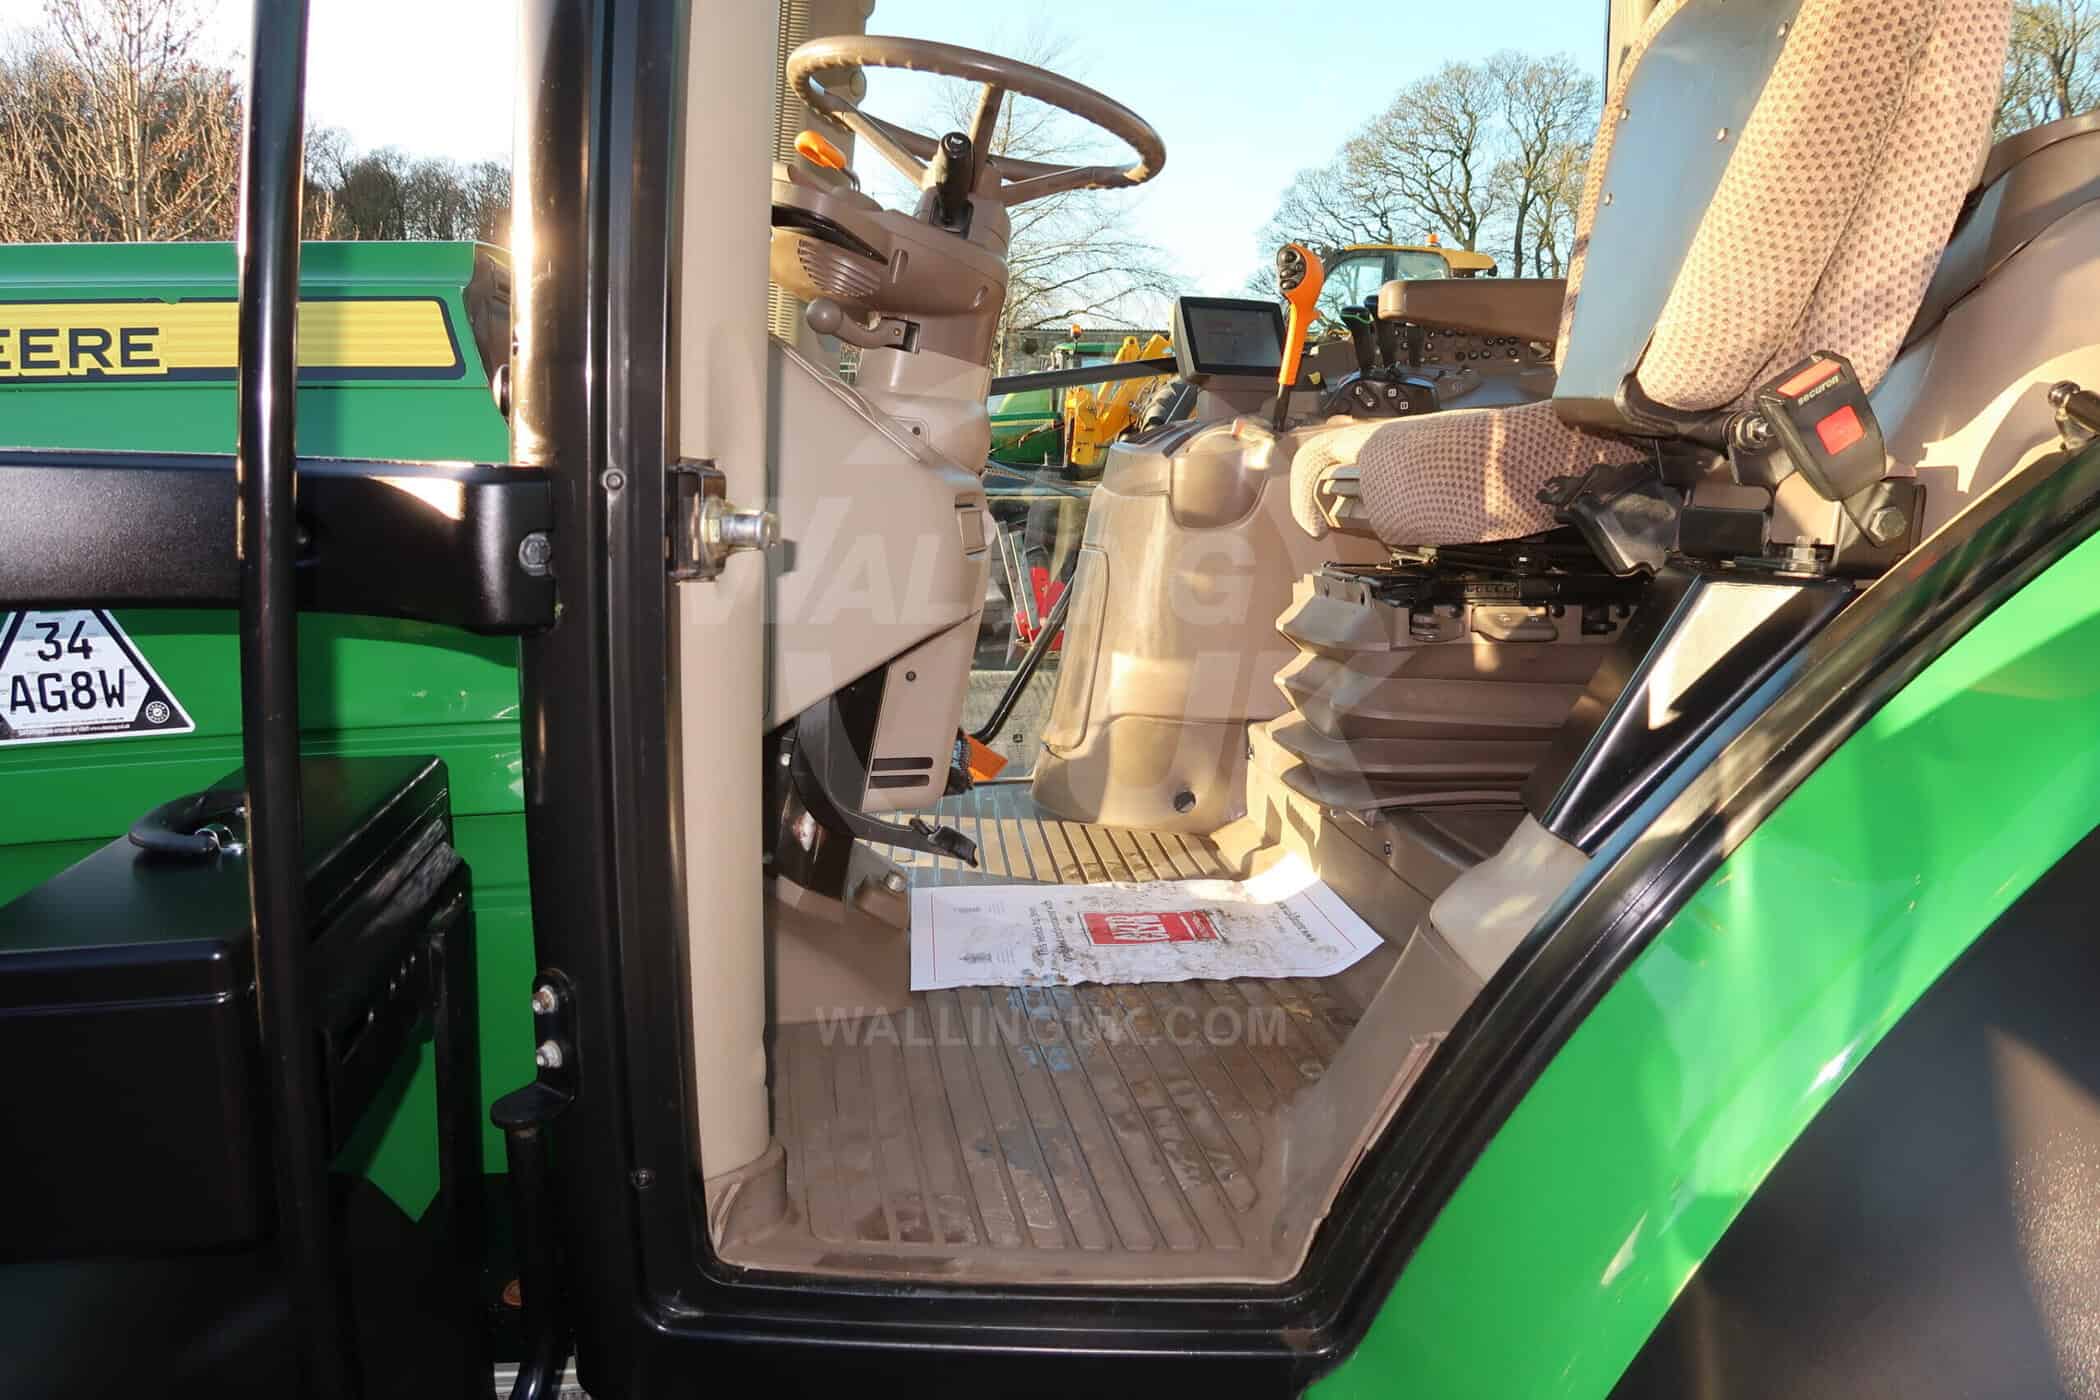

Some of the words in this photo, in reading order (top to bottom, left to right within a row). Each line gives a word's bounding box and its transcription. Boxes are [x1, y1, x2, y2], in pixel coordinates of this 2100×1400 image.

[0, 327, 161, 370] ERE
[1798, 375, 1840, 407] securon
[35, 620, 94, 662] 34
[10, 668, 126, 714] AG8W
